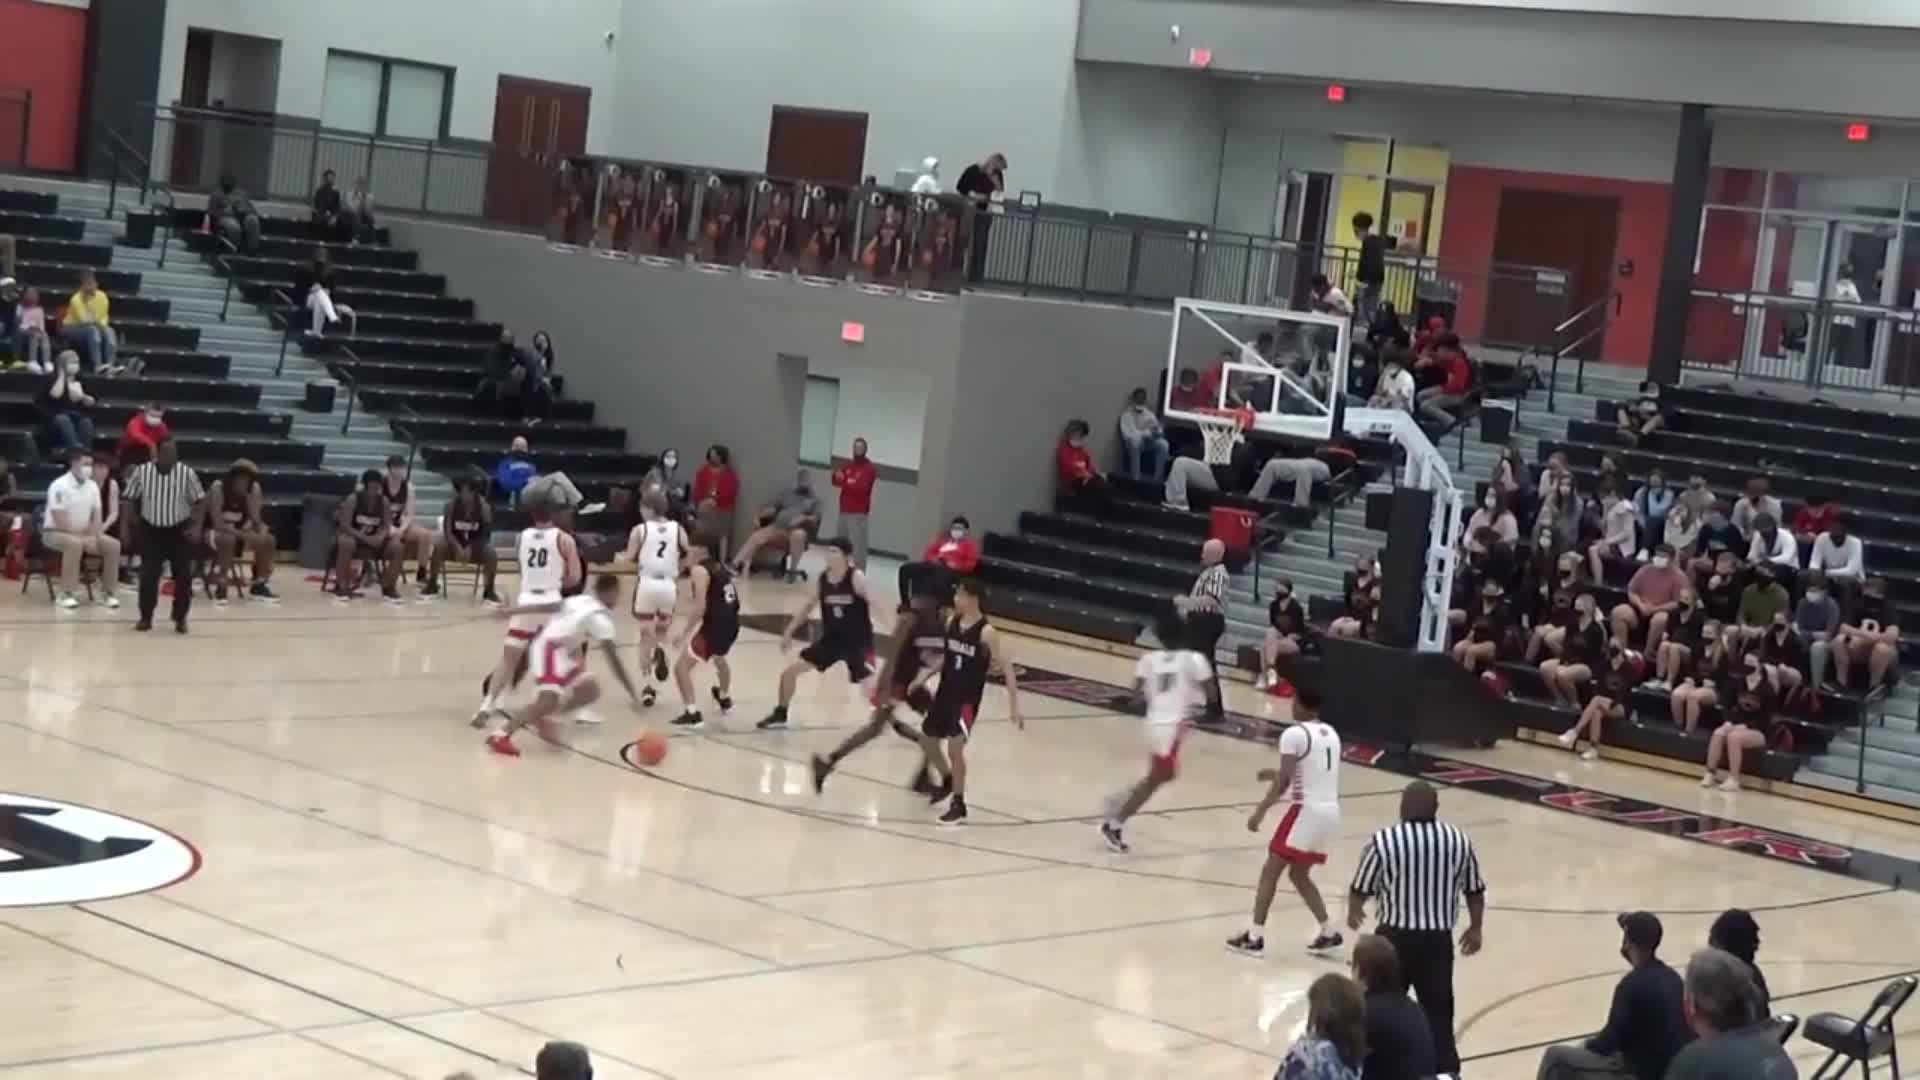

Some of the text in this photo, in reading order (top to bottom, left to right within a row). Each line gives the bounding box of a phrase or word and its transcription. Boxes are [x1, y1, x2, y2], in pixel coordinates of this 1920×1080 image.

[528, 548, 547, 567] 20
[656, 541, 666, 558] 2
[1326, 747, 1332, 770] 1
